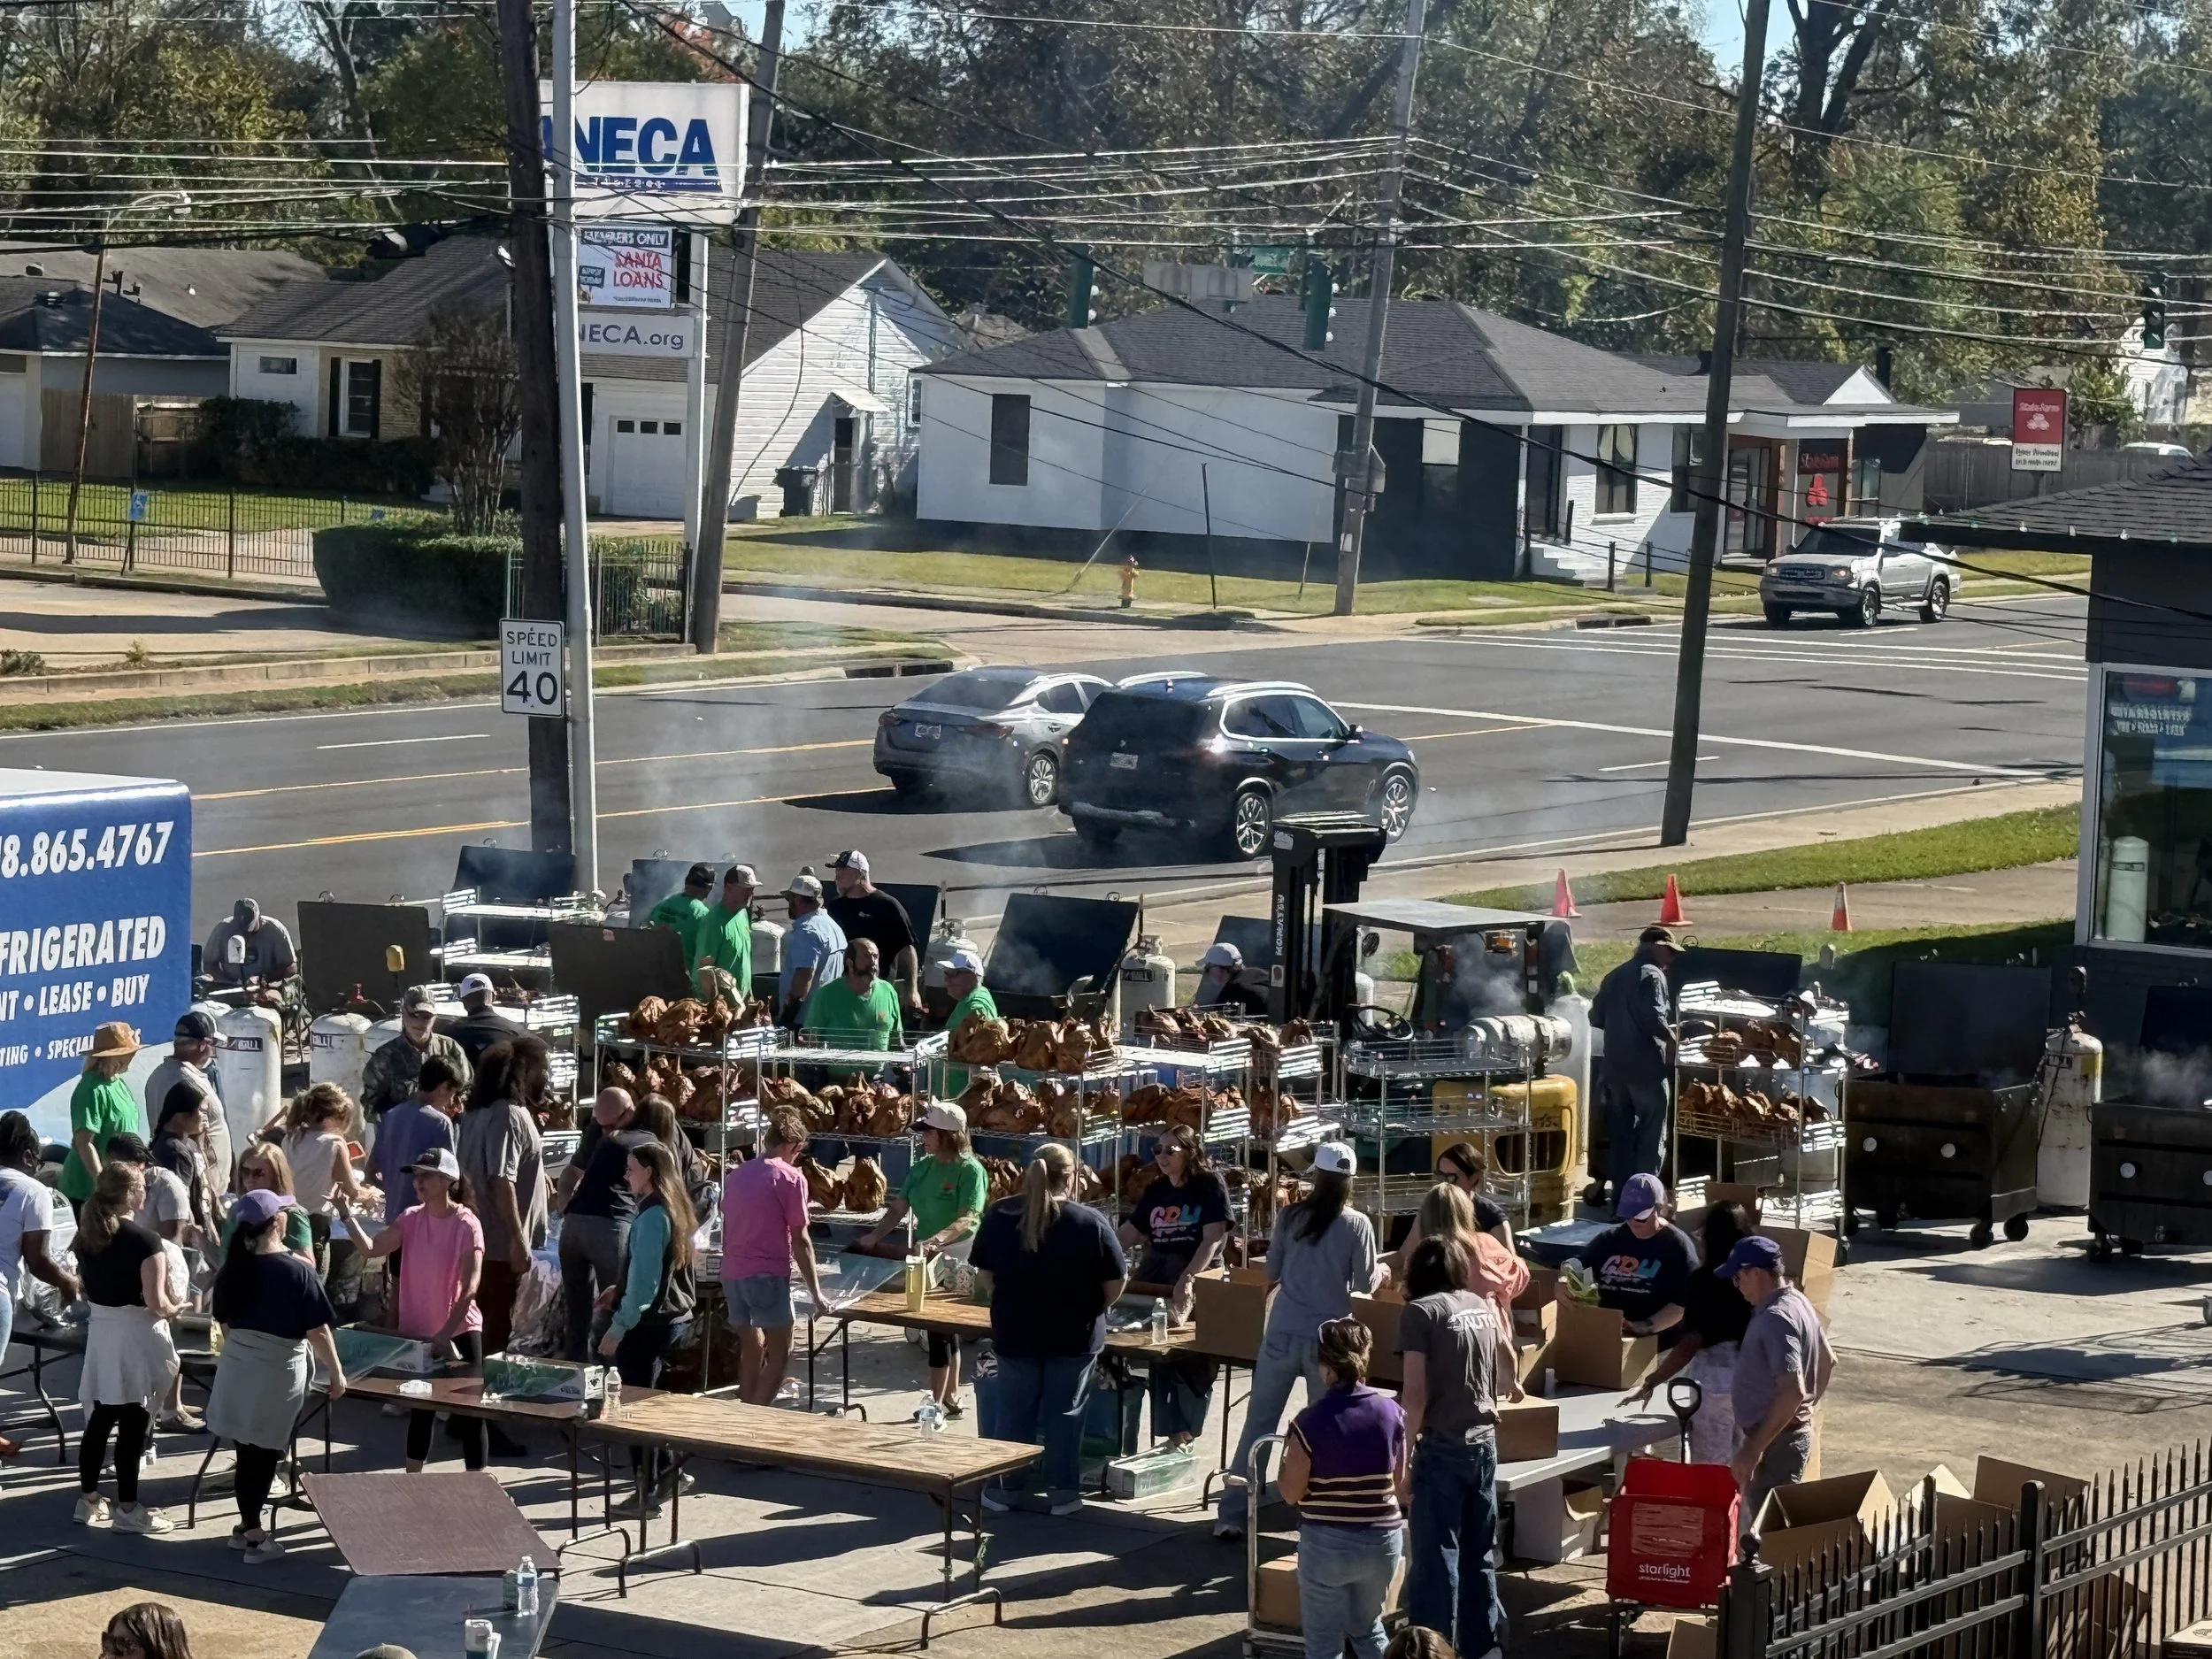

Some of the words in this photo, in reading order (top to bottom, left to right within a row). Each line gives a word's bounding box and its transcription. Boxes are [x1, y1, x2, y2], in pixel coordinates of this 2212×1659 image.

[541, 116, 718, 176] NECA
[637, 233, 665, 245] ONLY
[613, 271, 663, 289] LOANS
[506, 631, 557, 647] SPEED
[512, 650, 551, 666] LIMIT
[506, 671, 557, 705] 40
[0, 821, 174, 879] 8.865.4767
[38, 981, 94, 1017] LEASE
[111, 973, 150, 1008] BUY
[1639, 1563, 1691, 1578] starlight
